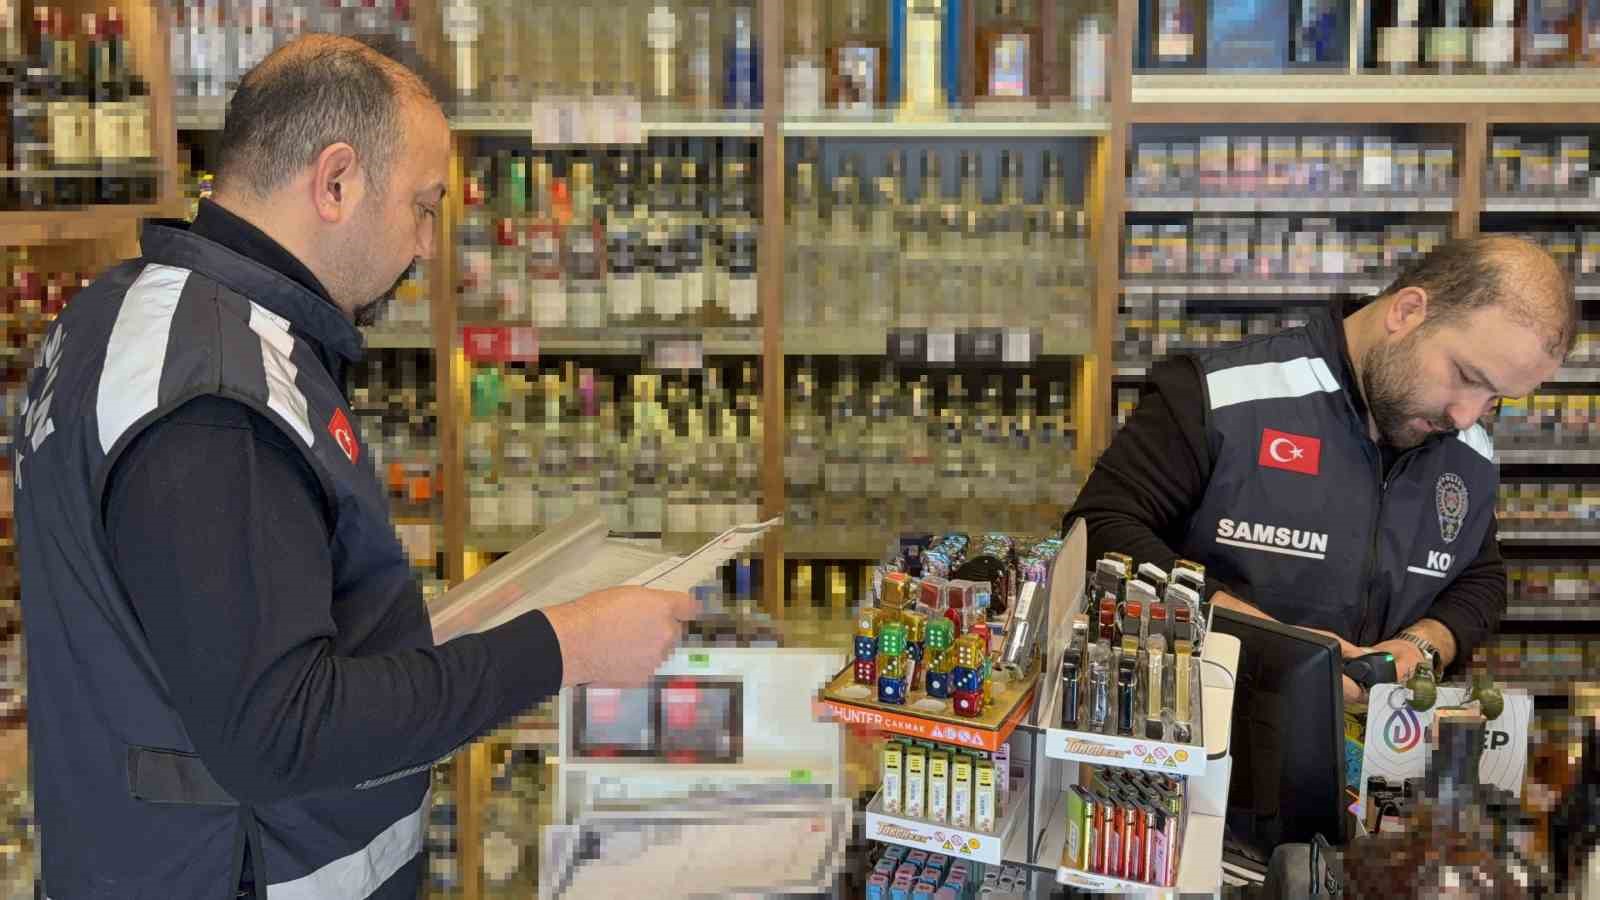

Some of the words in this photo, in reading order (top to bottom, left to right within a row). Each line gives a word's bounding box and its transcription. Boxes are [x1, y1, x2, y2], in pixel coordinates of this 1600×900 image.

[1217, 518, 1328, 552] SAMSUN
[1427, 550, 1455, 571] KO
[834, 705, 882, 724] HUNTER
